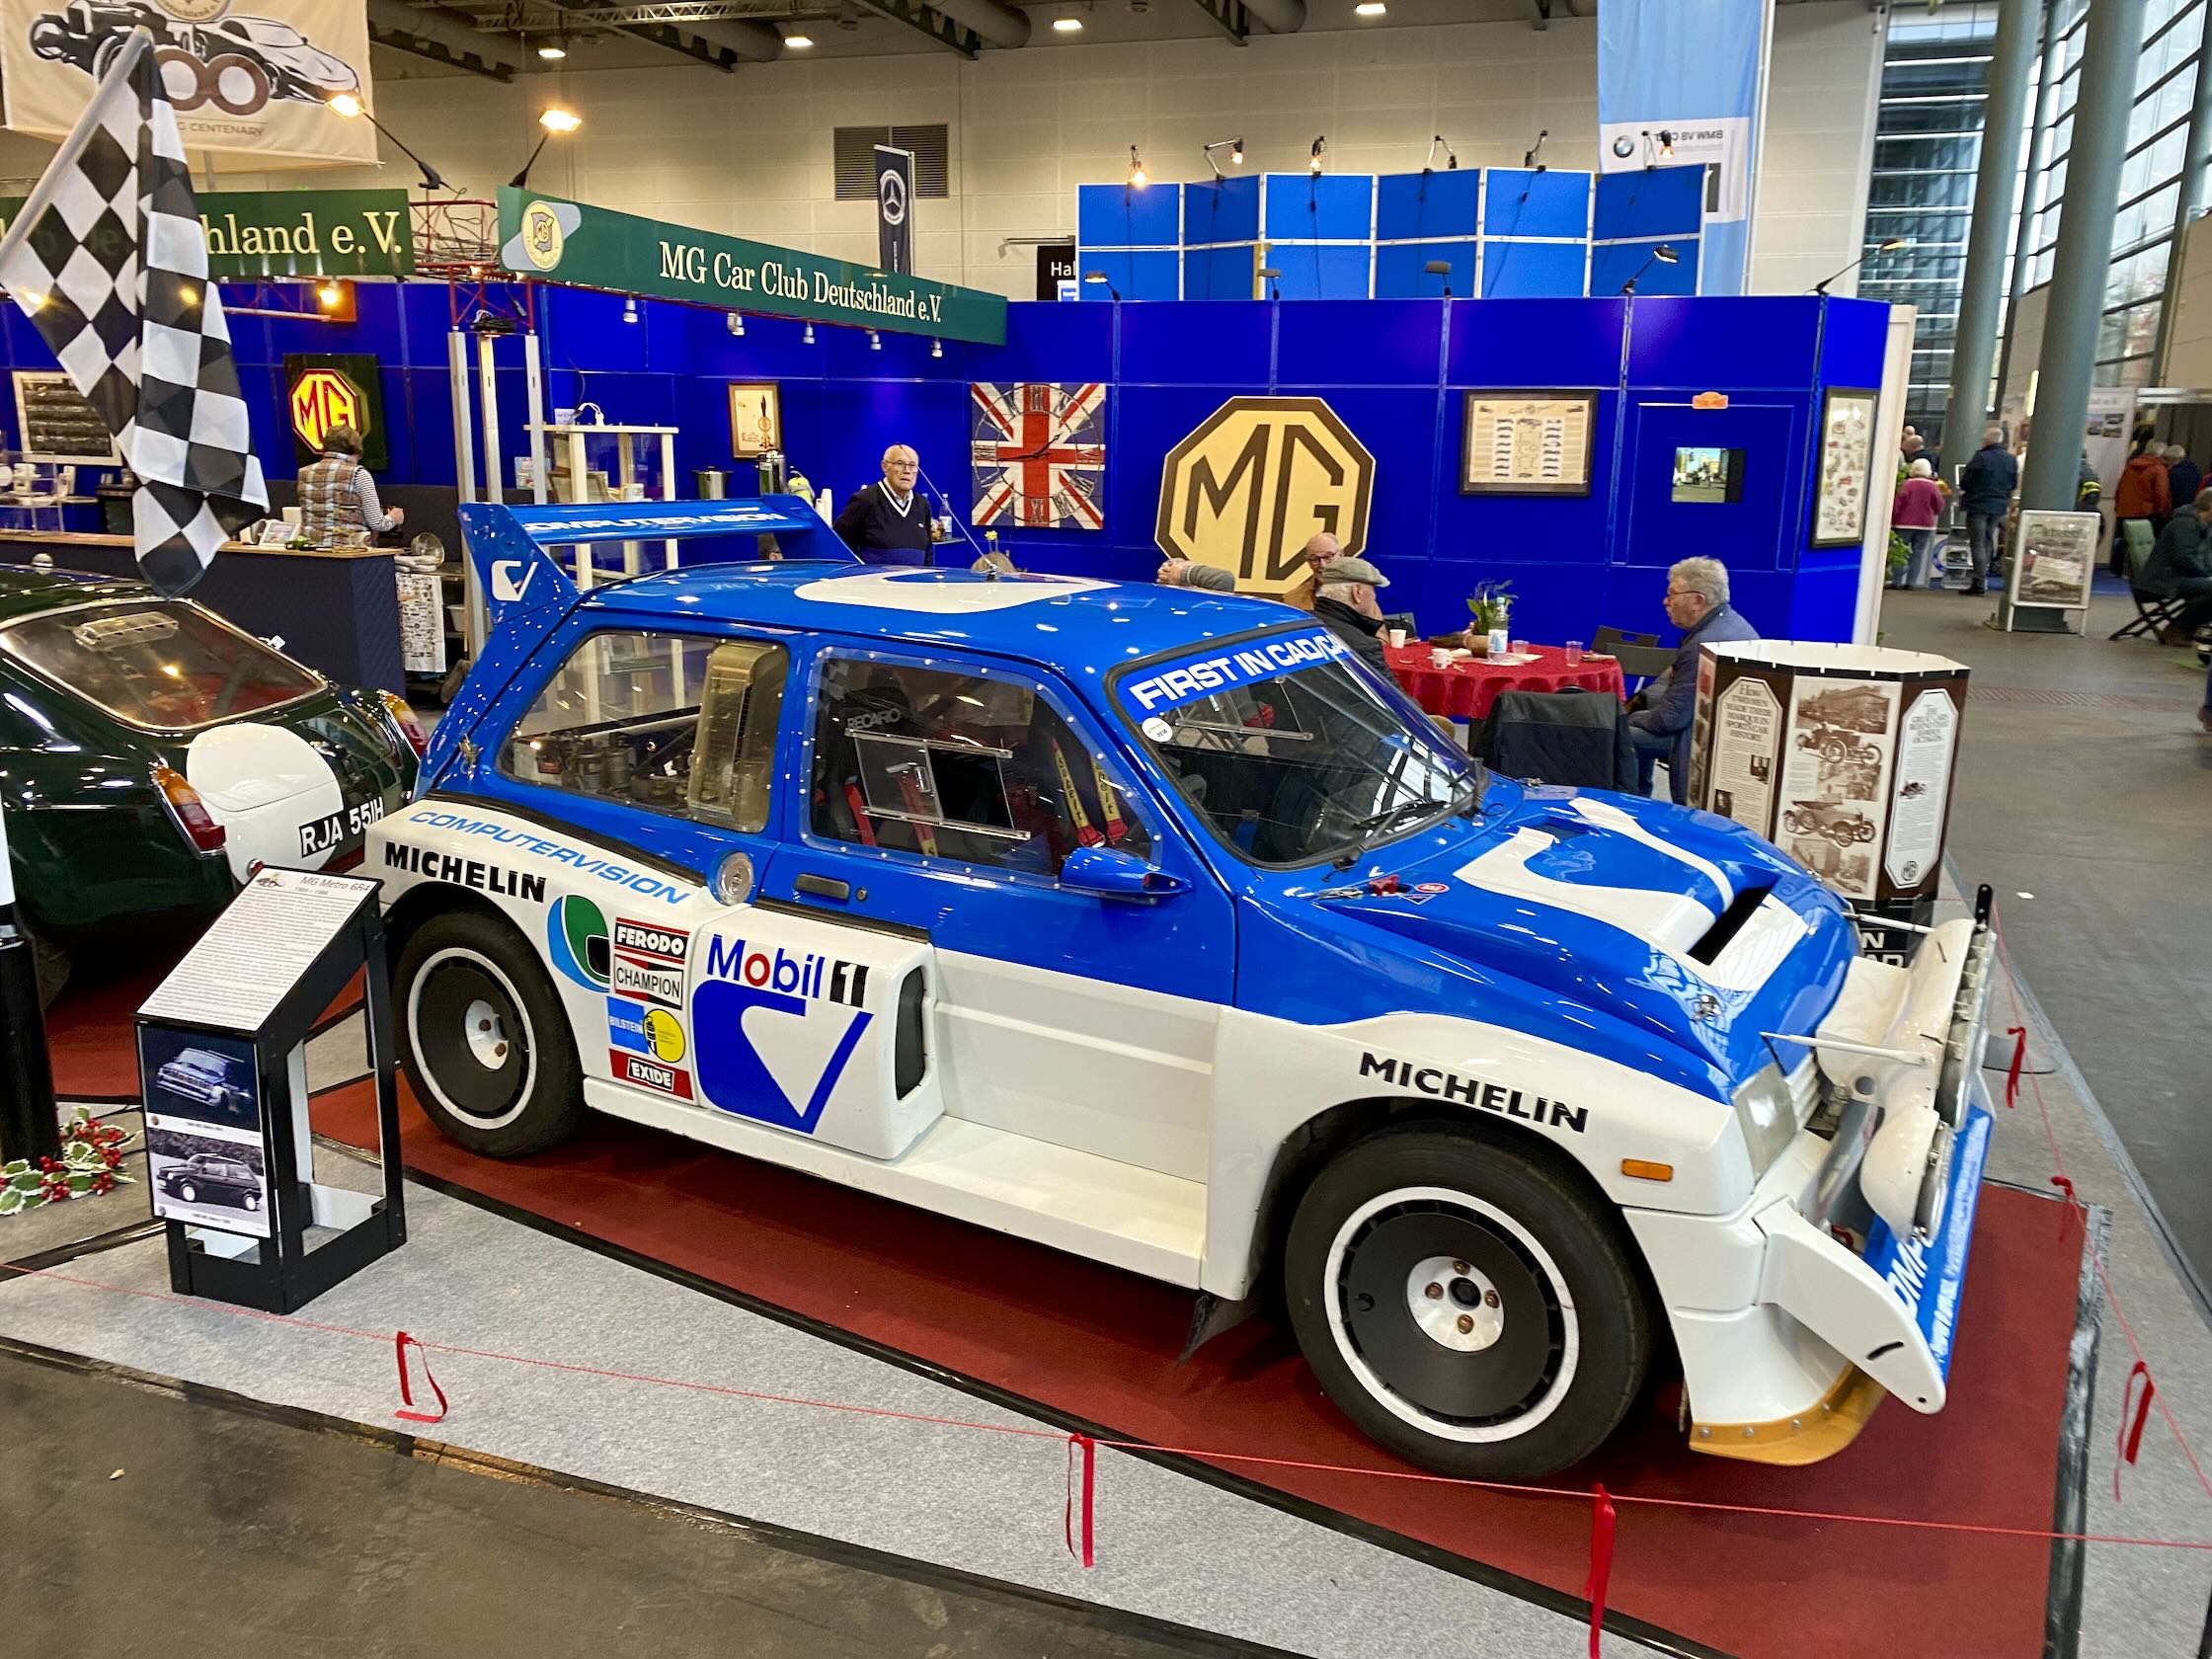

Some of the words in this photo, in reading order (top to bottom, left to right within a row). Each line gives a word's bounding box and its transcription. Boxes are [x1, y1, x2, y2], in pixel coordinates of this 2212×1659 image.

[189, 123, 265, 136] CENTENARY
[200, 211, 320, 255] hland
[331, 210, 403, 255] e.V.
[659, 241, 707, 284] MG
[713, 252, 754, 291] Car
[760, 261, 808, 300] Club
[813, 272, 914, 319] Deutschland
[917, 293, 941, 323] e.V.
[1051, 261, 1076, 276] Hal
[1183, 423, 1345, 581] MG
[1129, 661, 1240, 710] FIRST
[1232, 648, 1271, 676] IN
[847, 708, 901, 729] RECARO
[300, 816, 344, 856] RJA
[384, 841, 547, 904] MICHELIN
[409, 811, 690, 906] COMPUTERVISION
[299, 876, 319, 886] MG
[319, 879, 349, 890] Metro
[350, 883, 370, 893] 6R4
[616, 925, 685, 956] FERODO
[616, 967, 681, 998] CHAMPION
[707, 933, 826, 998] Mobil
[630, 1062, 672, 1088] EXIDE
[1359, 1051, 1589, 1134] MICHELIN
